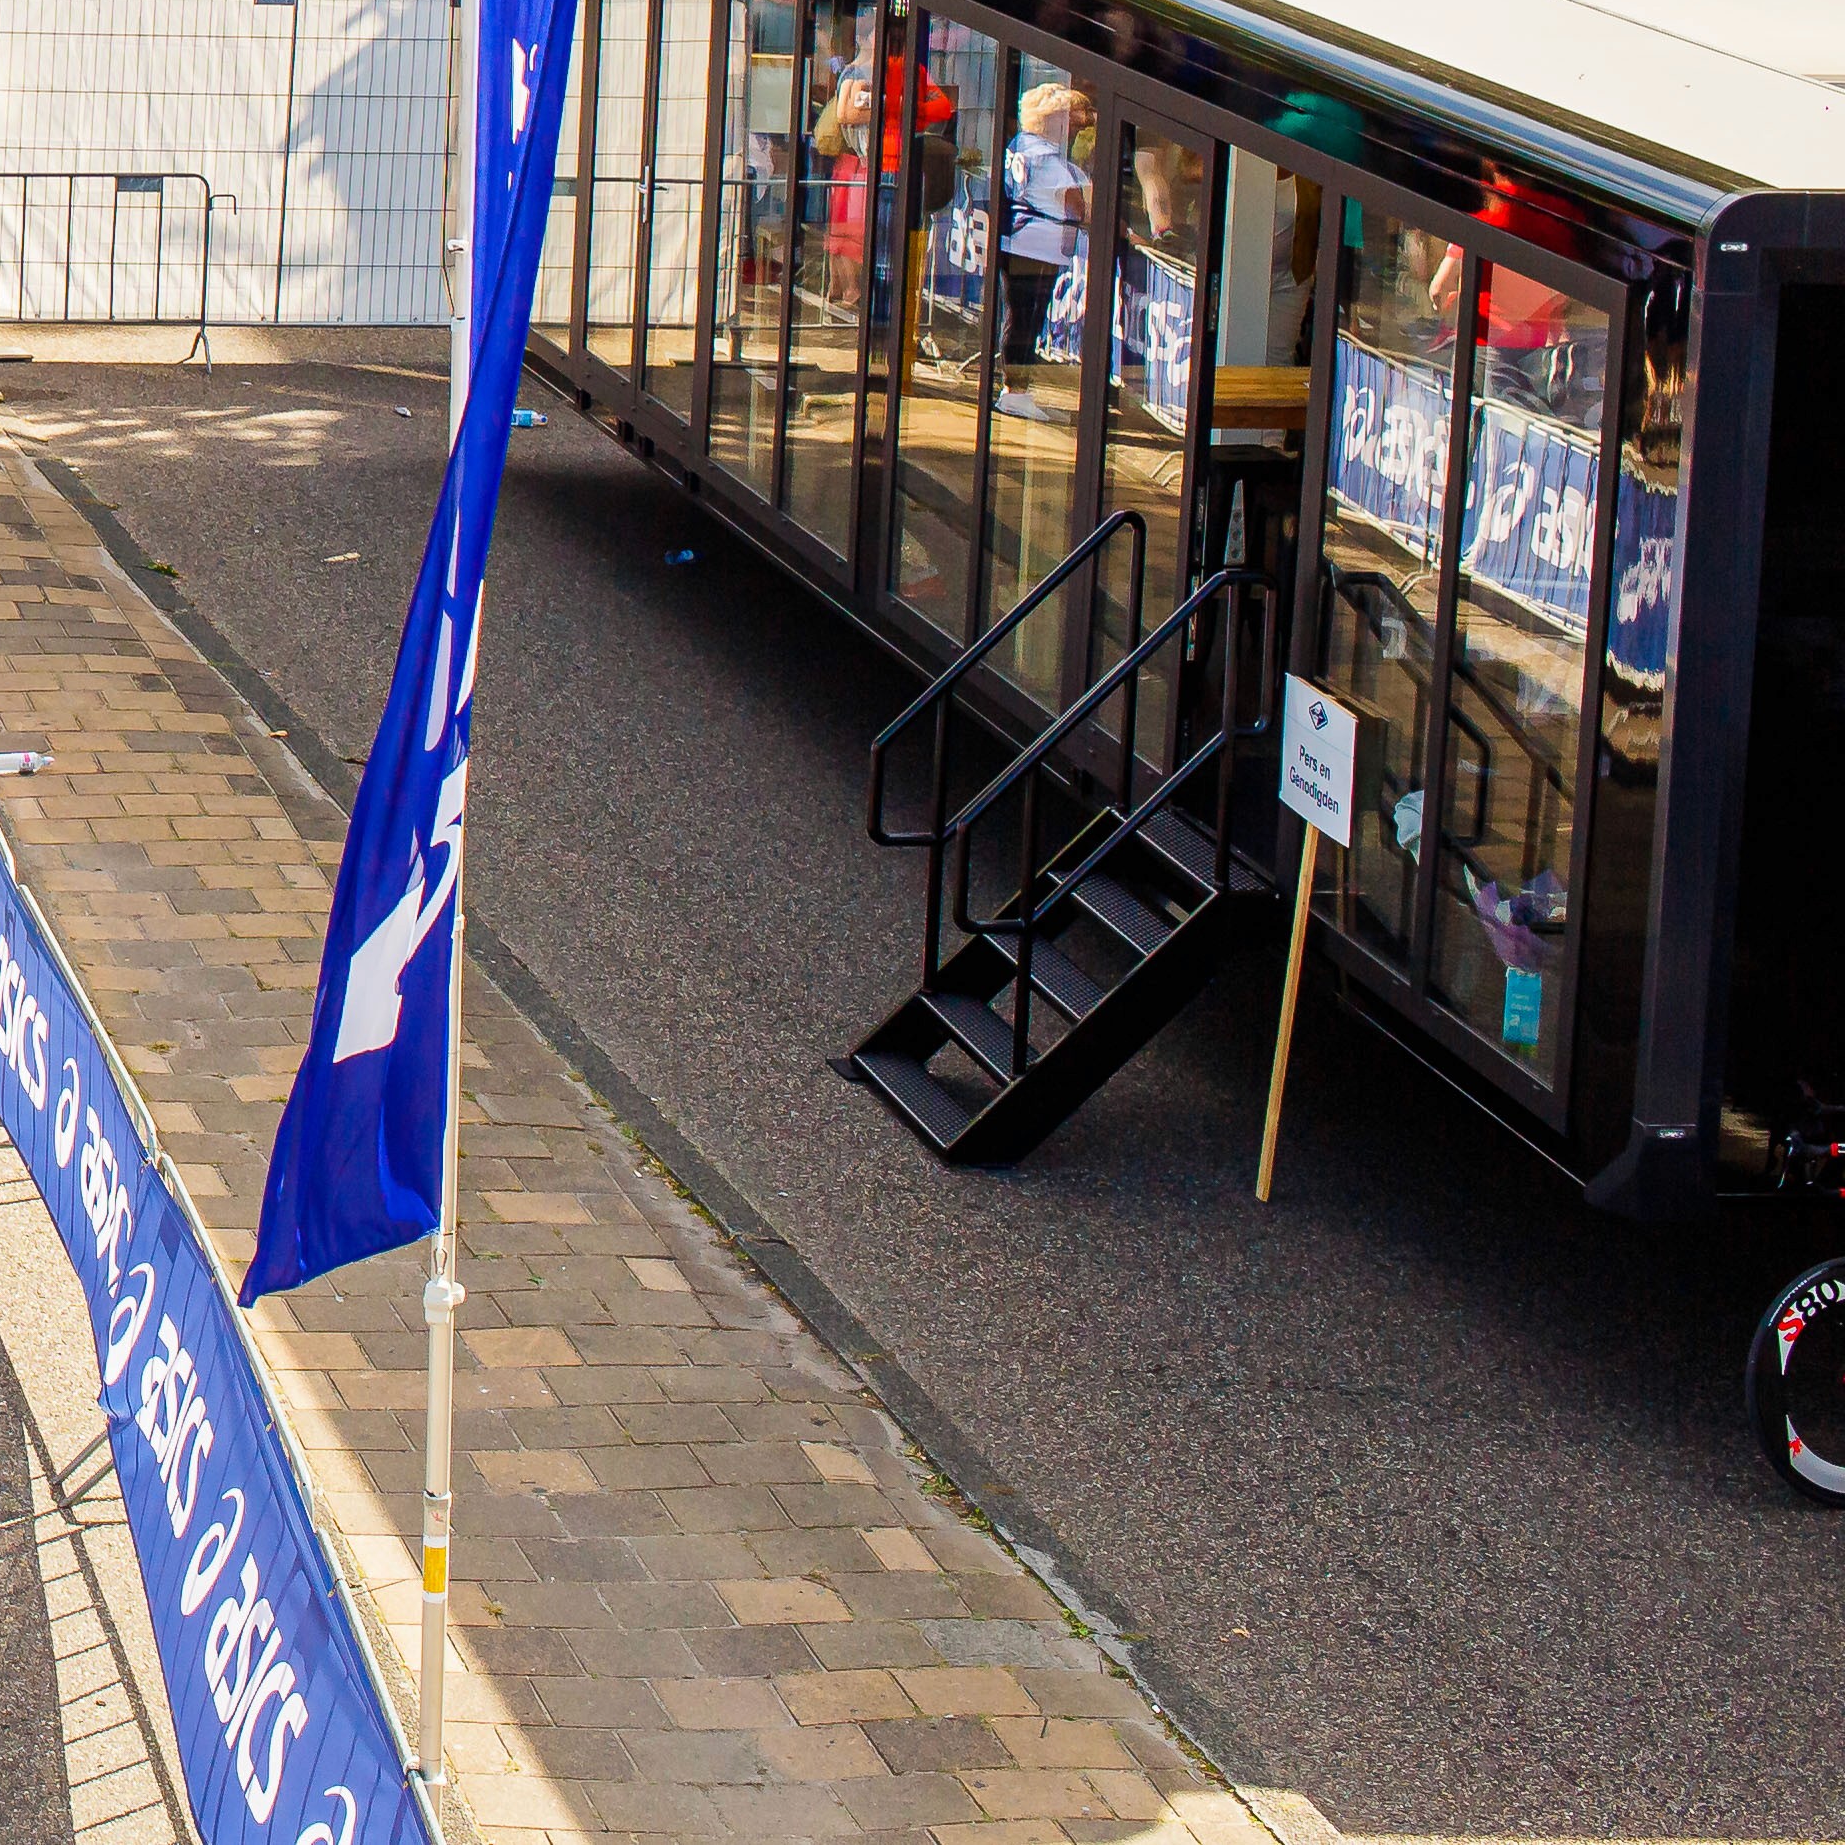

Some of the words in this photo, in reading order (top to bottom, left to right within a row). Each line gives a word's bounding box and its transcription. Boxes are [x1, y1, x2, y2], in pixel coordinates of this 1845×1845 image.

[1298, 743, 1319, 772] Pers
[1319, 762, 1333, 781] en
[1288, 764, 1339, 815] Genodigden
[203, 1552, 309, 1826] asics
